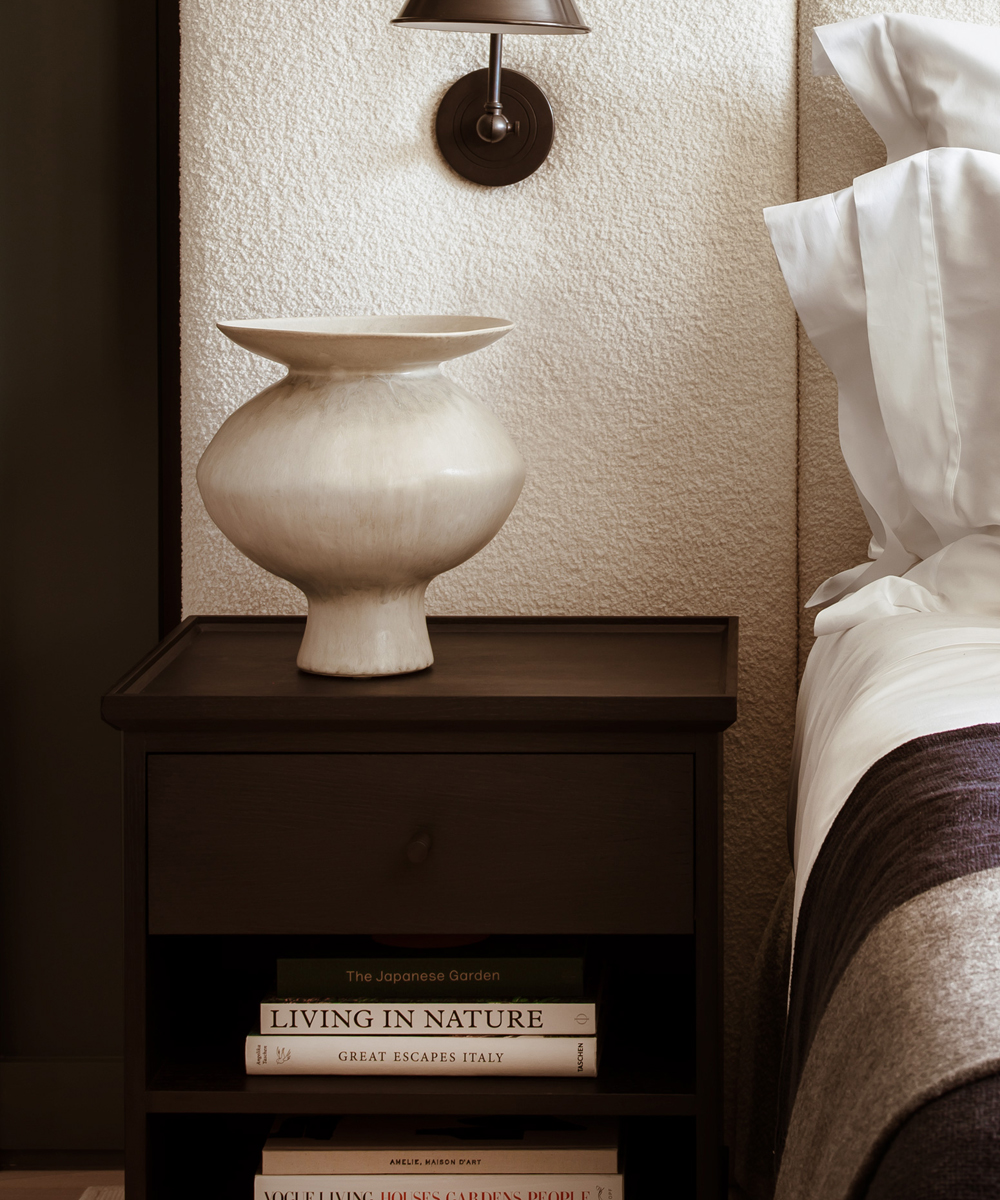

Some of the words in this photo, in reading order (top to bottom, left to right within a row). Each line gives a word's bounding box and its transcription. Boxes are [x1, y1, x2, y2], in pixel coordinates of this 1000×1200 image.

[346, 970, 373, 983] The
[376, 970, 445, 984] Japanese
[449, 969, 500, 982] Garden
[270, 1009, 374, 1029] LIVING
[382, 1009, 415, 1029] IN
[425, 1009, 544, 1029] NATURE
[338, 1051, 387, 1062] GREAT
[393, 1051, 456, 1063] ESCAPES
[462, 1052, 504, 1064] ITALY
[425, 1158, 456, 1166] MAISON
[459, 1158, 482, 1166] D'ART
[264, 1191, 315, 1200] VOGUE
[319, 1191, 373, 1200] LIVING
[528, 1191, 591, 1200] PEOPLE
